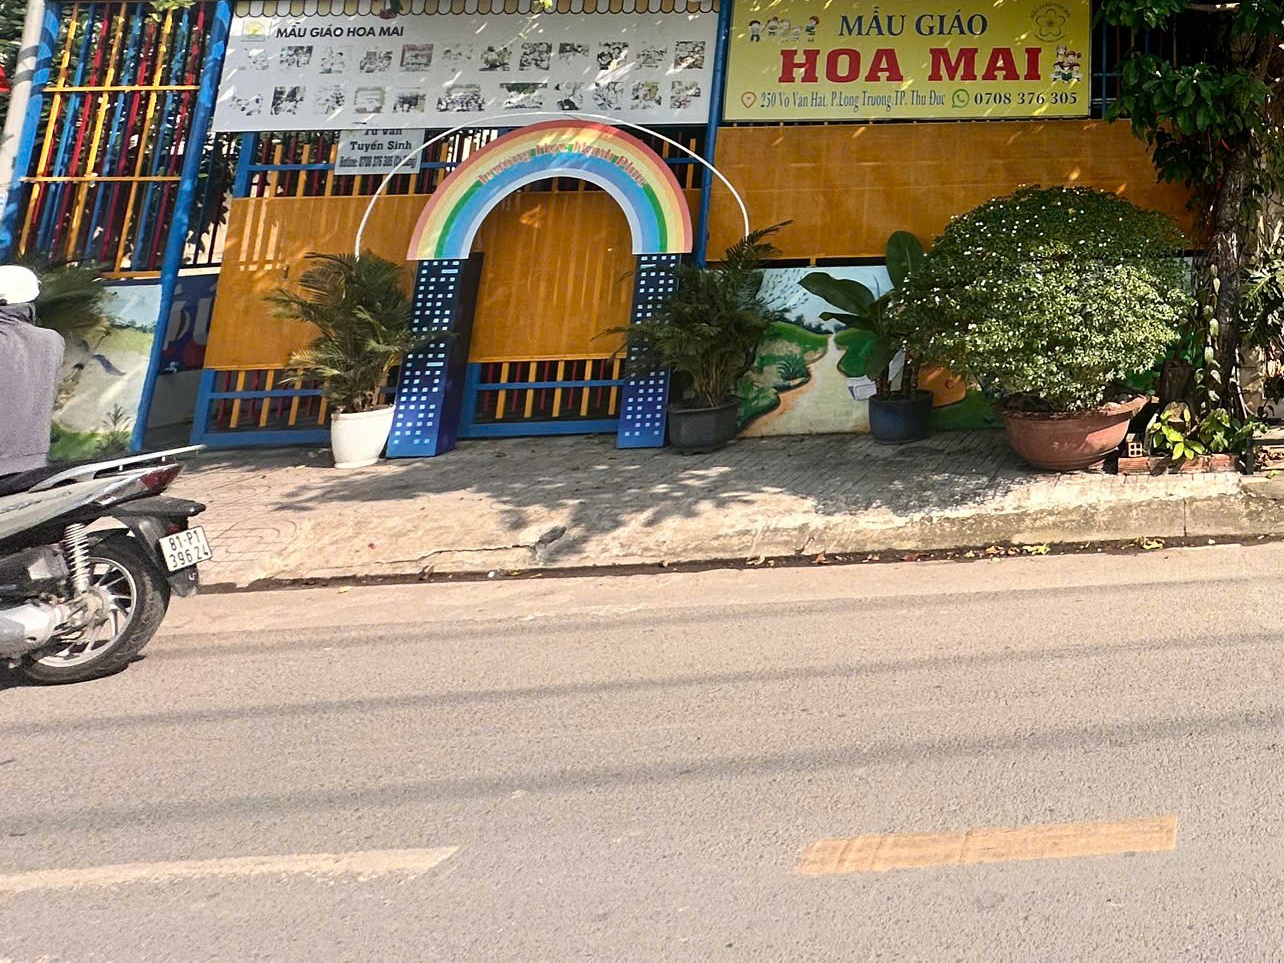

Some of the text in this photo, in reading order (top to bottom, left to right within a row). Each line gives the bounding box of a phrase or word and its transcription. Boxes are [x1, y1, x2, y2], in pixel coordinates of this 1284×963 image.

[915, 9, 987, 36] GIÁO
[310, 23, 344, 38] GIÁO
[347, 26, 376, 37] HOA
[379, 25, 404, 37] MAI
[778, 47, 1043, 83] HOA MAI
[760, 92, 776, 108] 250
[974, 92, 1078, 105] 0708 376 305
[387, 141, 412, 150] Sinh
